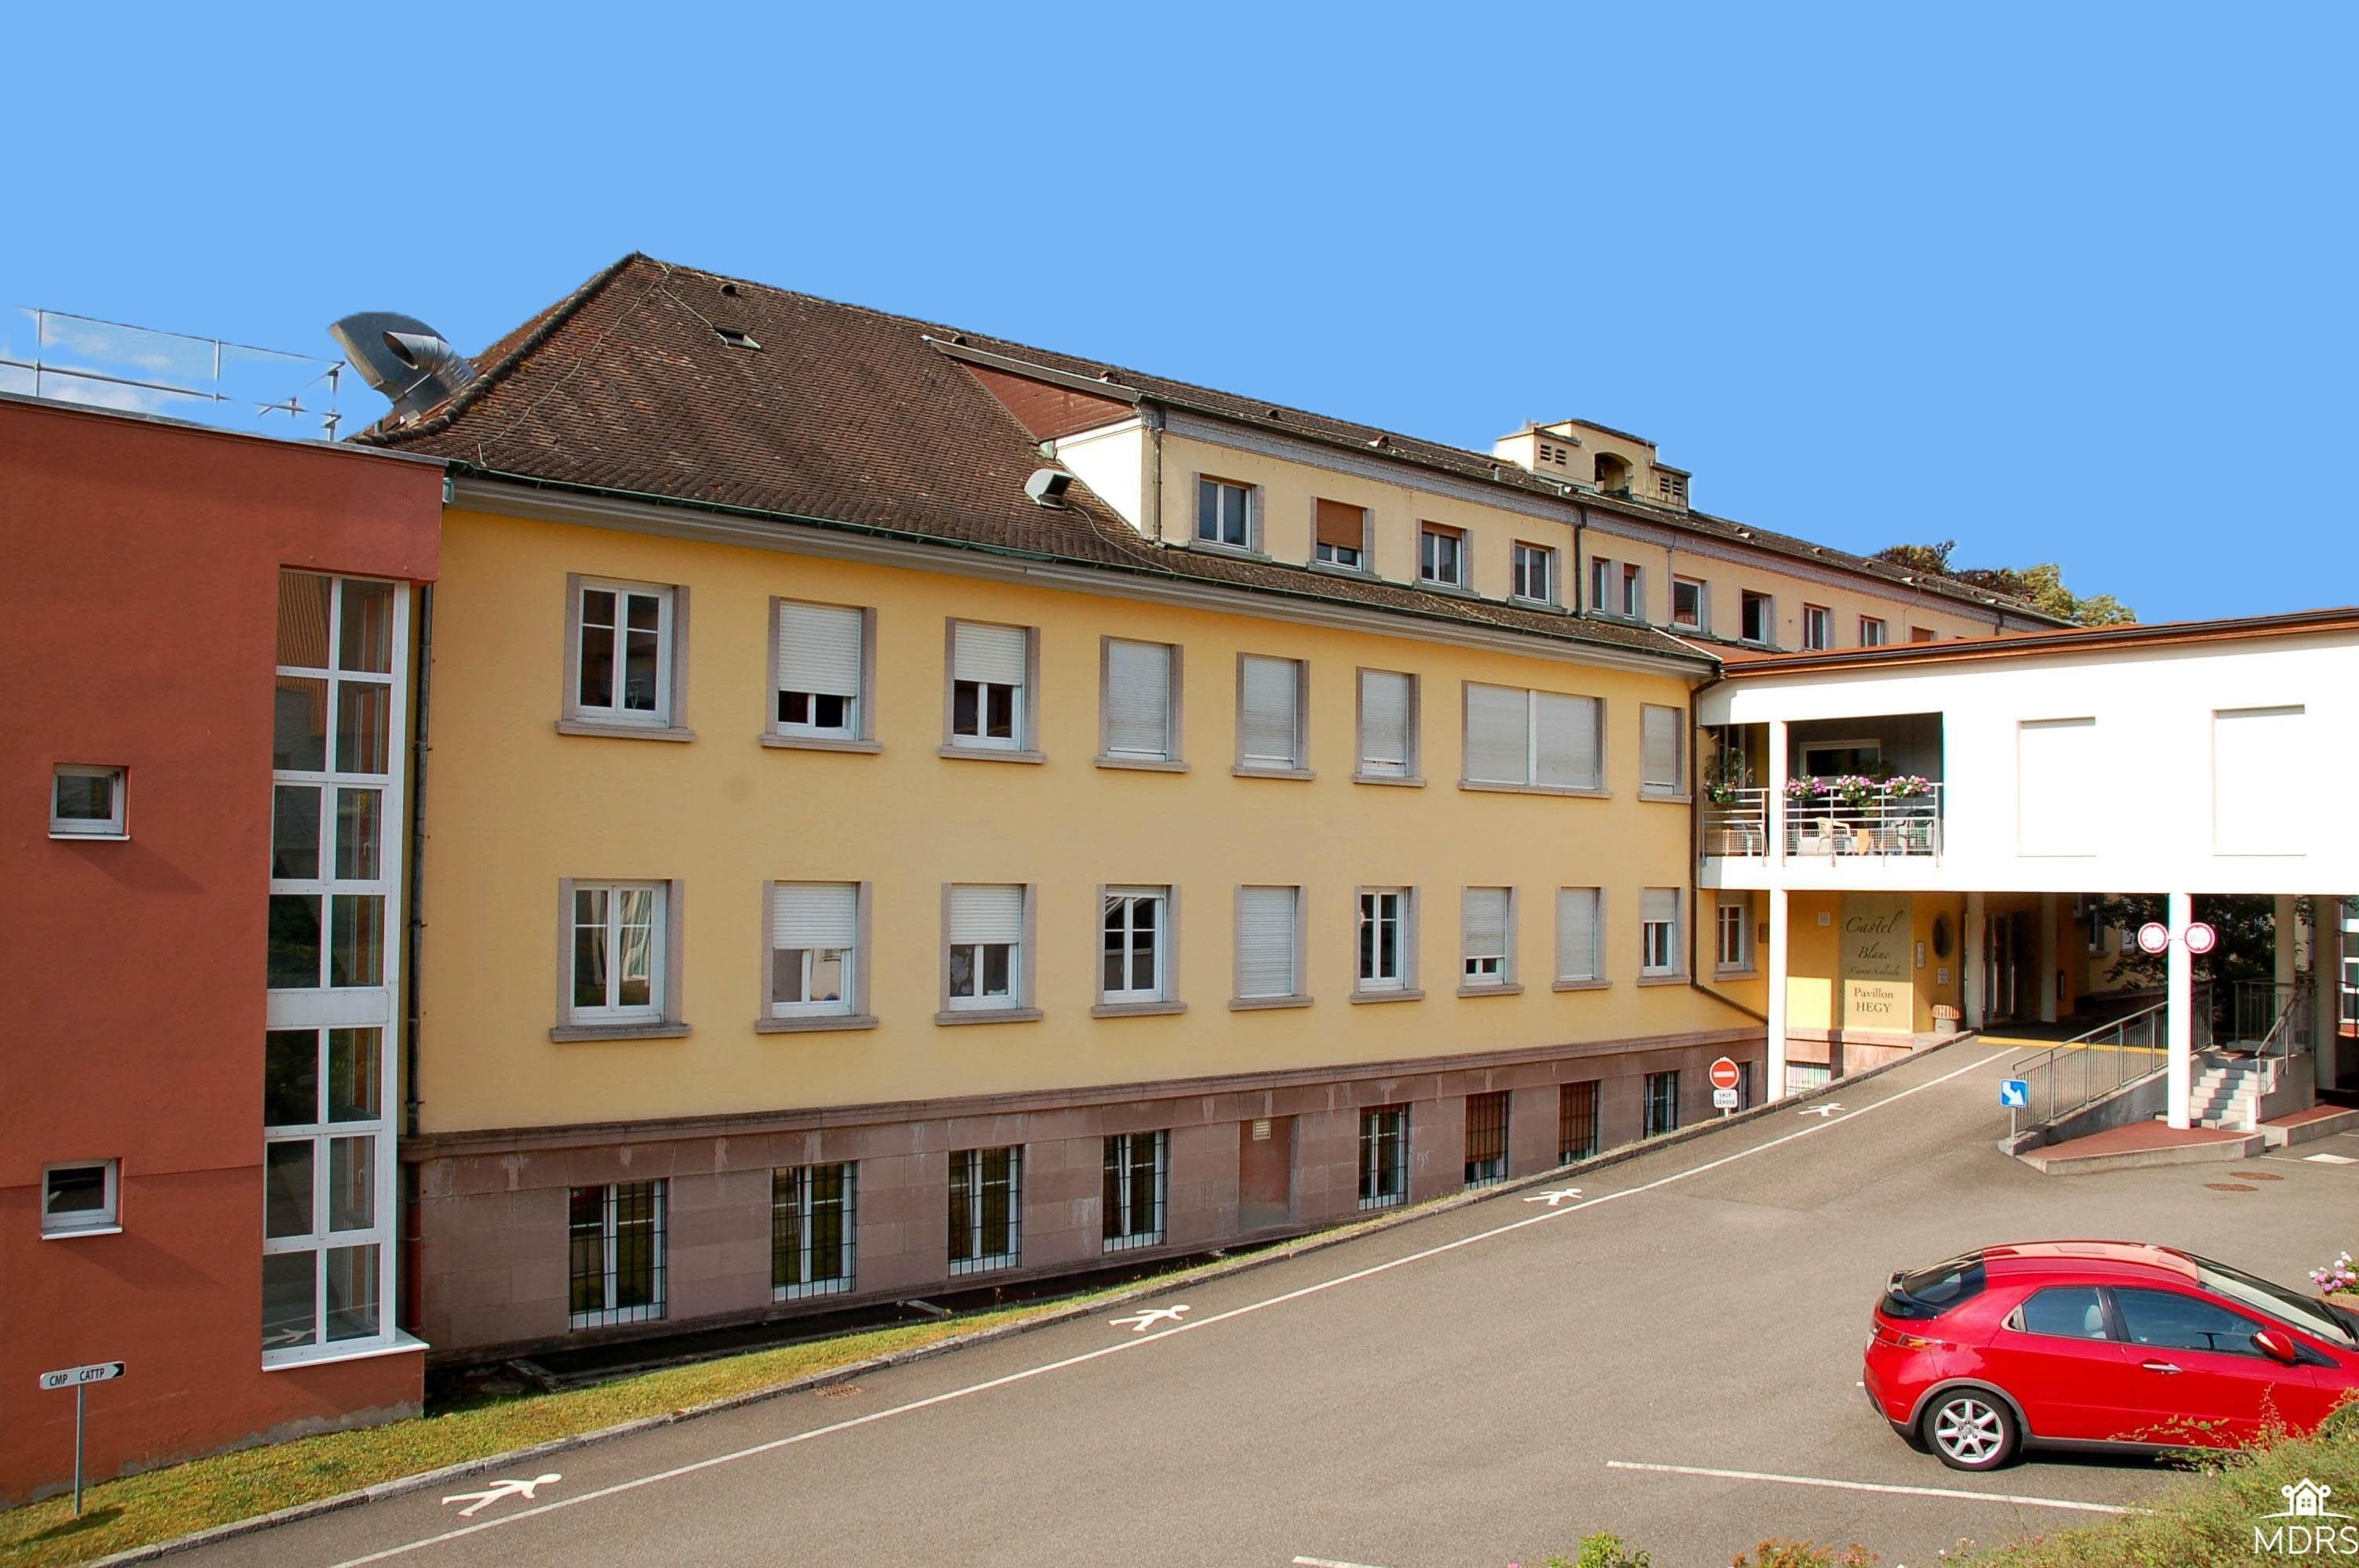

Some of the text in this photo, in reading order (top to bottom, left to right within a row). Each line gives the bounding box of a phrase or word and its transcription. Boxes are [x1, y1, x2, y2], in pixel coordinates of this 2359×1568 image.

[1846, 910, 1903, 935] Castel
[1858, 942, 1891, 960] Blanc
[1854, 986, 1894, 999] Pavillon
[1856, 1001, 1892, 1013] HEGY
[49, 1367, 105, 1386] CMP CATTP
